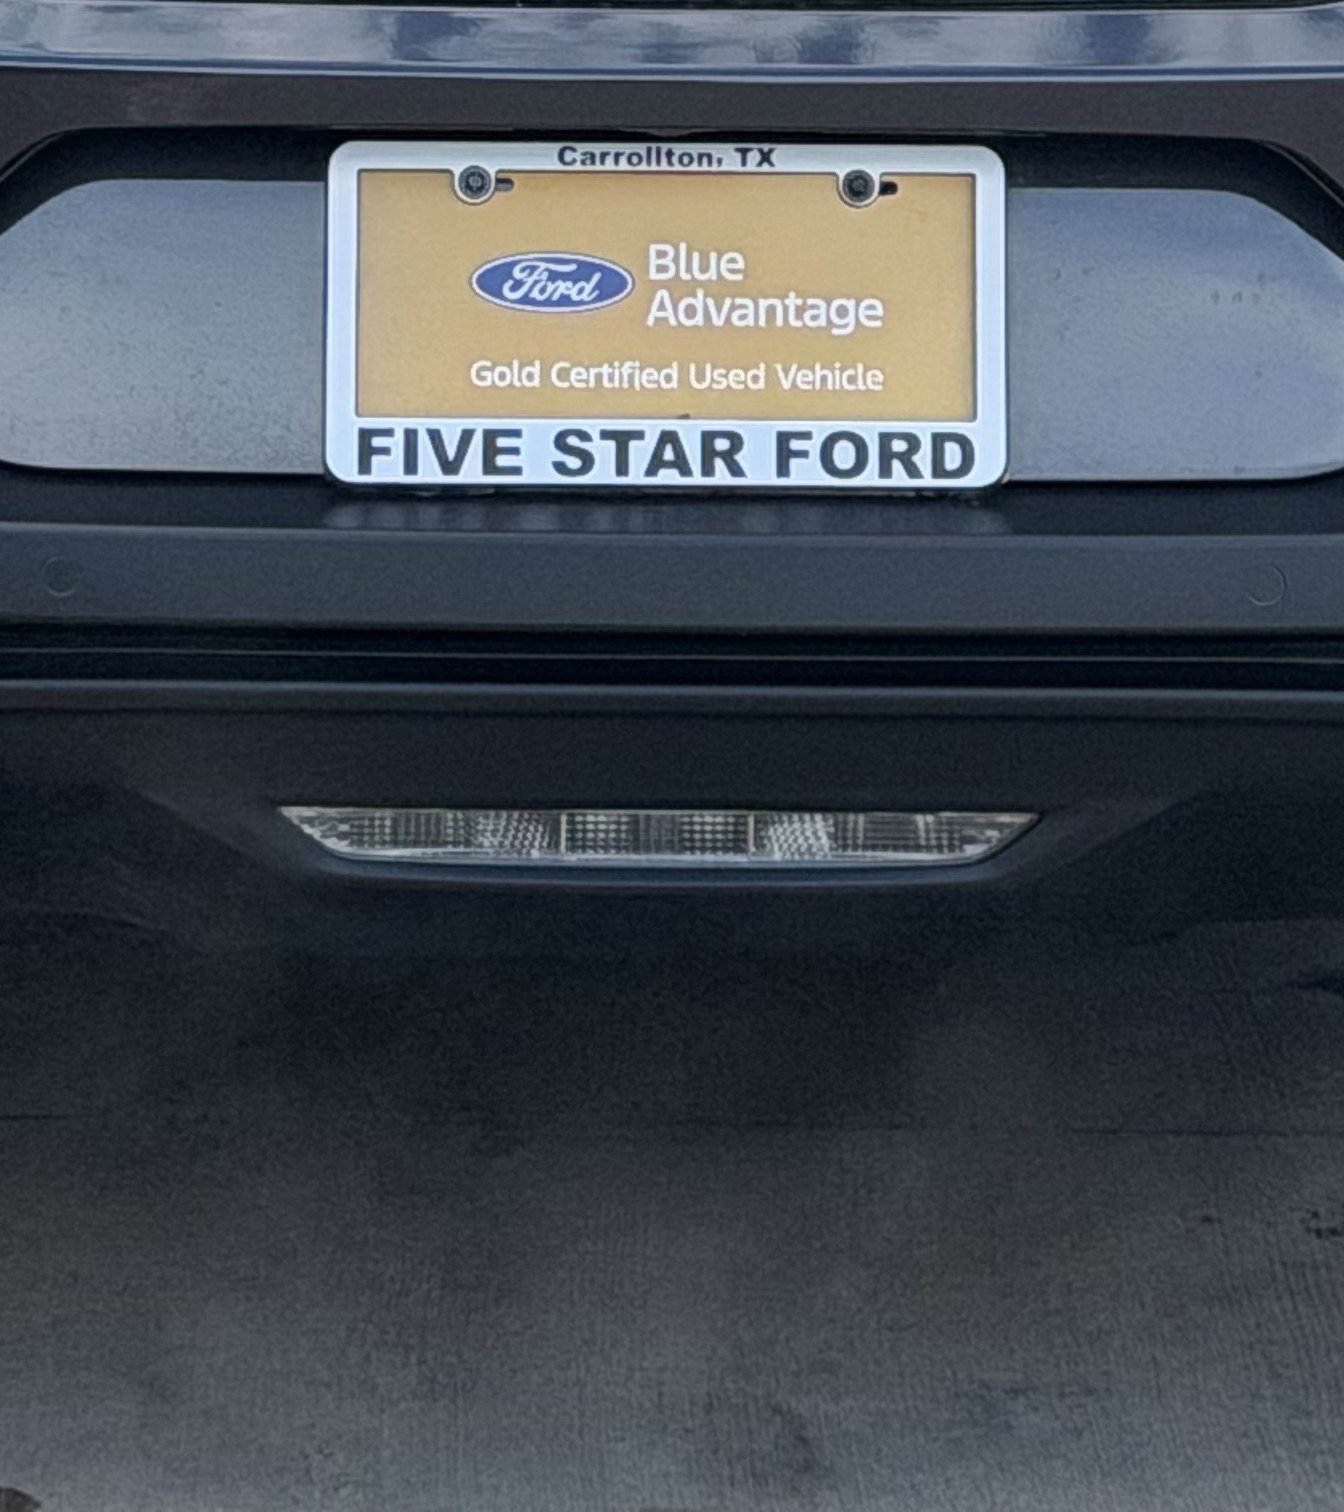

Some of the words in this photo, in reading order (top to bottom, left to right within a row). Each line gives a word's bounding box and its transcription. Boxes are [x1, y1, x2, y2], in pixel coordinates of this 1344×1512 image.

[557, 145, 723, 168] Carrollton,
[734, 147, 776, 168] TX
[503, 261, 599, 303] Ford
[648, 243, 745, 282] Blue
[646, 289, 884, 336] Advantage
[470, 360, 541, 388] Gold
[550, 361, 678, 391] Certified
[689, 363, 765, 390] Used
[775, 363, 884, 392] Vehicle
[358, 427, 524, 476] FIVE
[551, 429, 746, 479] STAR
[775, 430, 975, 480] FORD
